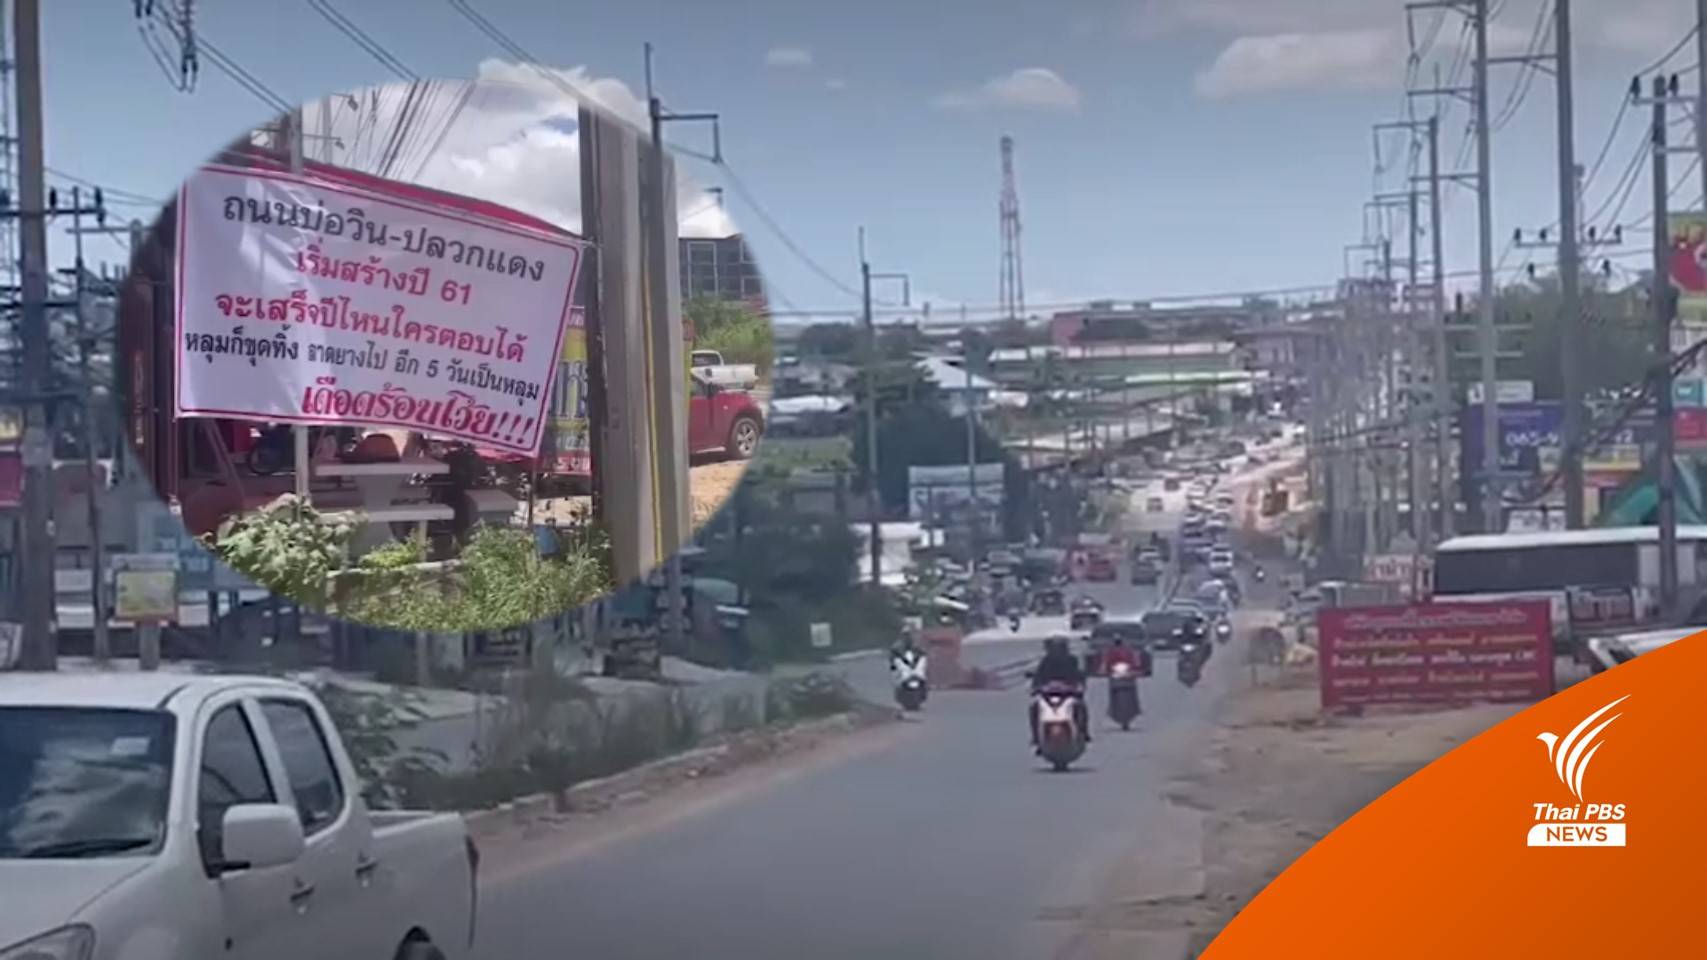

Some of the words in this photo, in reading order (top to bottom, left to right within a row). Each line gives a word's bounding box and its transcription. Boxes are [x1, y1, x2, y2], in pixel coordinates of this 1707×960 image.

[224, 196, 544, 281] ถนนบ่อวิน-ปลวกแดง
[297, 237, 431, 296] เริ่มสร้างปี
[441, 280, 471, 304] 61
[215, 289, 527, 362] จะเสร็จปีไหนใครตอบได้
[185, 325, 299, 367] หลุมก็ขุดทิ้ง
[426, 360, 441, 378] 5
[446, 359, 541, 406] วันเป็นหลุม
